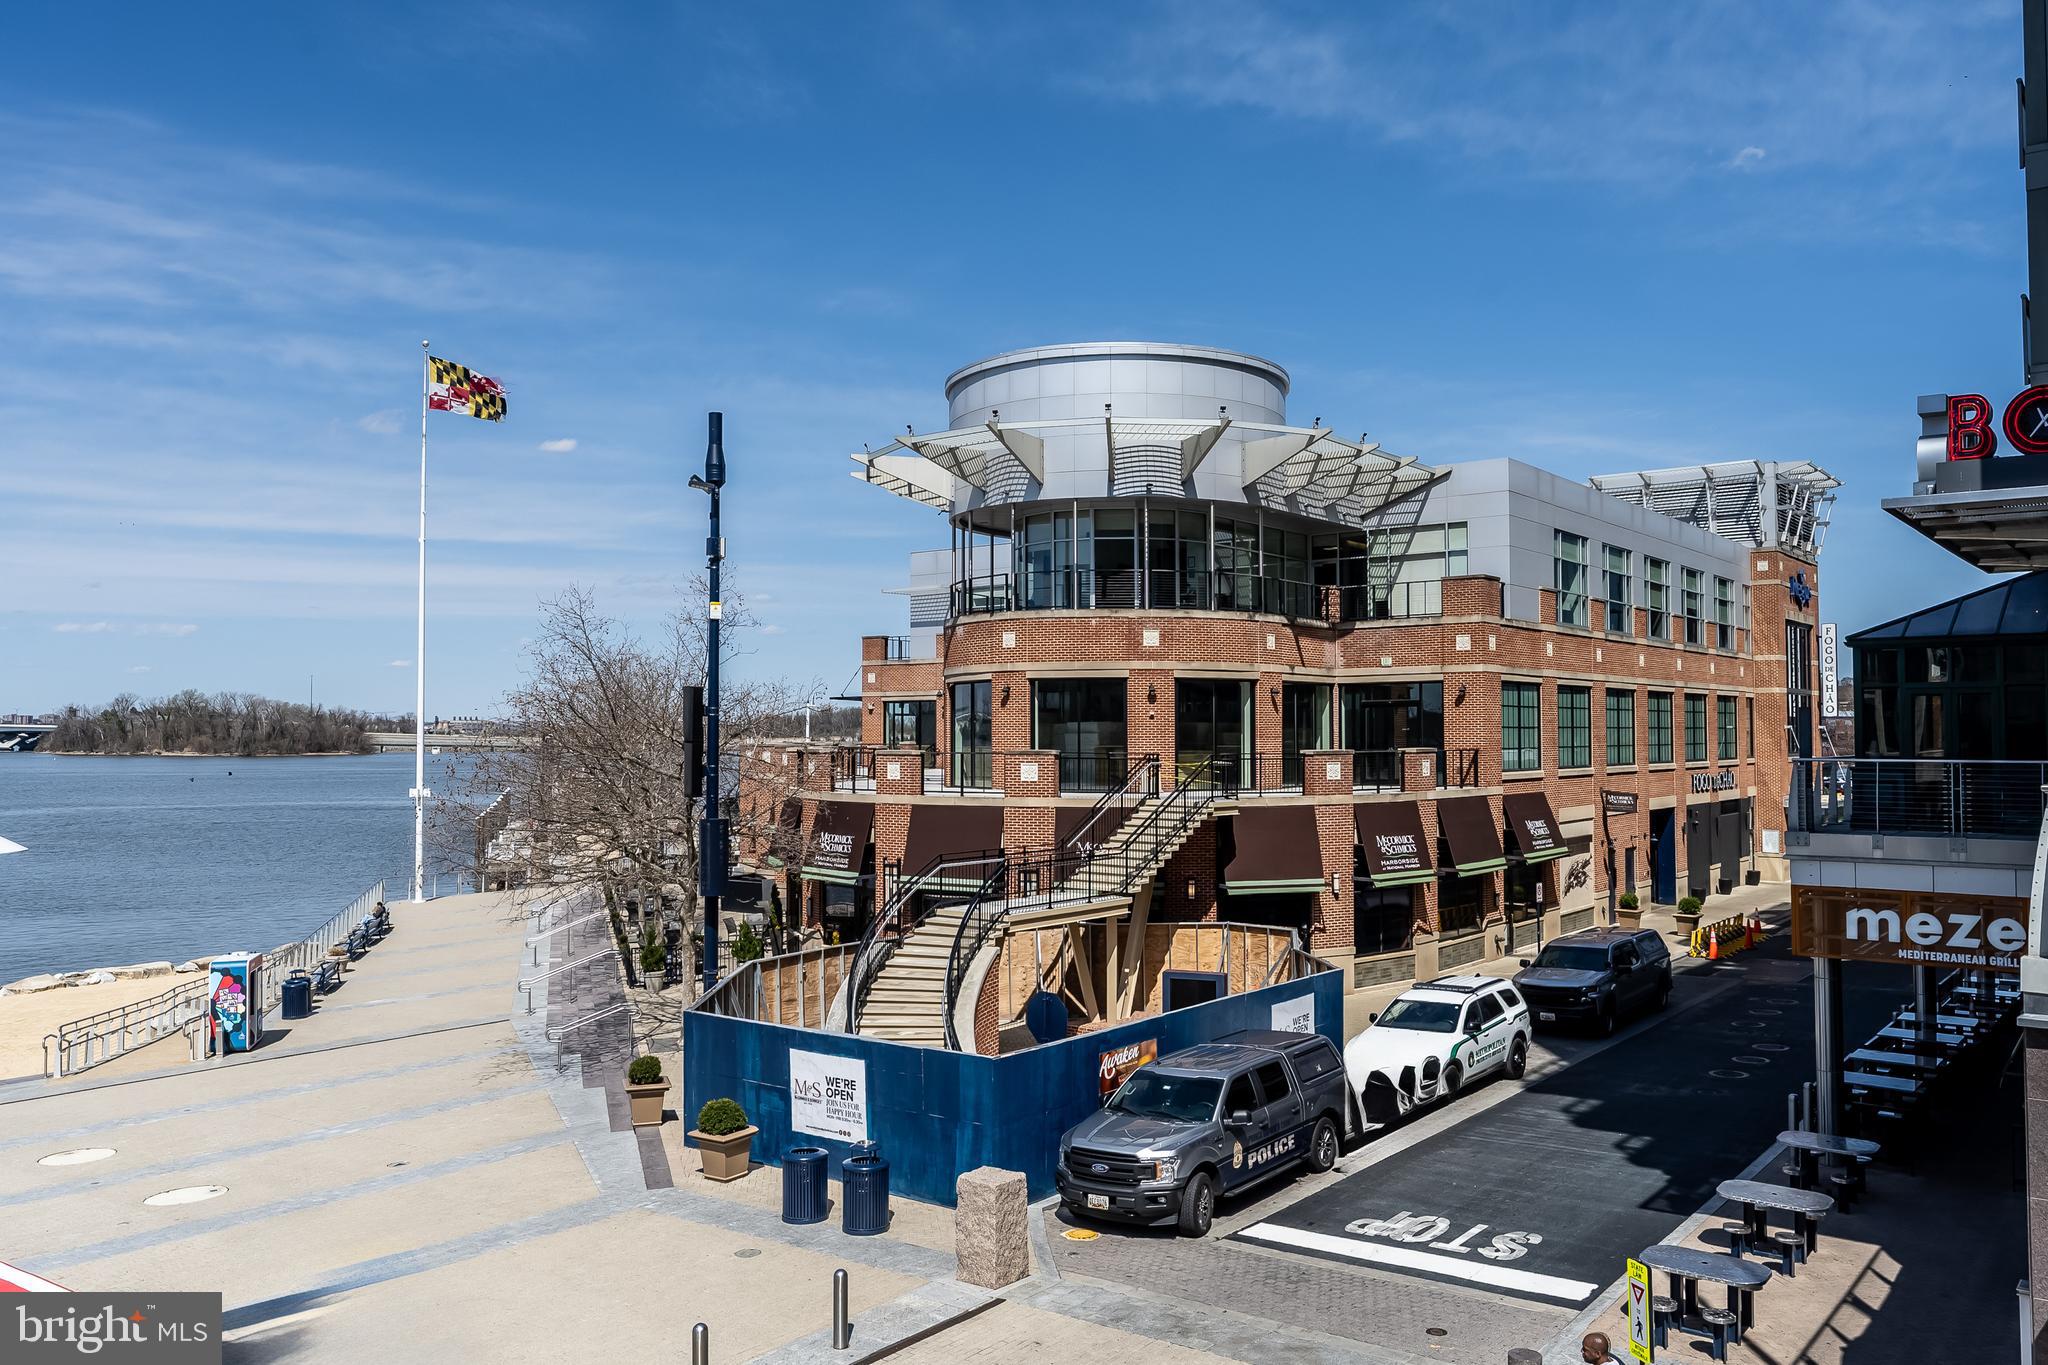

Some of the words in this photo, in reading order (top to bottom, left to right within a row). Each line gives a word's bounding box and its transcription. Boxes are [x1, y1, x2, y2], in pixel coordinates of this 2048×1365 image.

[1824, 627, 1834, 665] FOGO
[1693, 772, 1711, 790] FOGO
[1380, 857, 1419, 867] HARBORSIDE
[1845, 907, 2027, 951] meze
[1898, 949, 1986, 965] MEDITERRANEAN
[1989, 956, 2020, 967] GRILL
[1292, 1012, 1310, 1026] WE'RE
[1099, 1045, 1140, 1080] Awaken
[825, 1075, 857, 1091] WE'RE
[825, 1087, 854, 1102] OPEN
[826, 1106, 844, 1117] HAPPY
[845, 1109, 862, 1120] HOUR
[1247, 1133, 1296, 1170] POLICE
[1344, 1210, 1544, 1261] STOP
